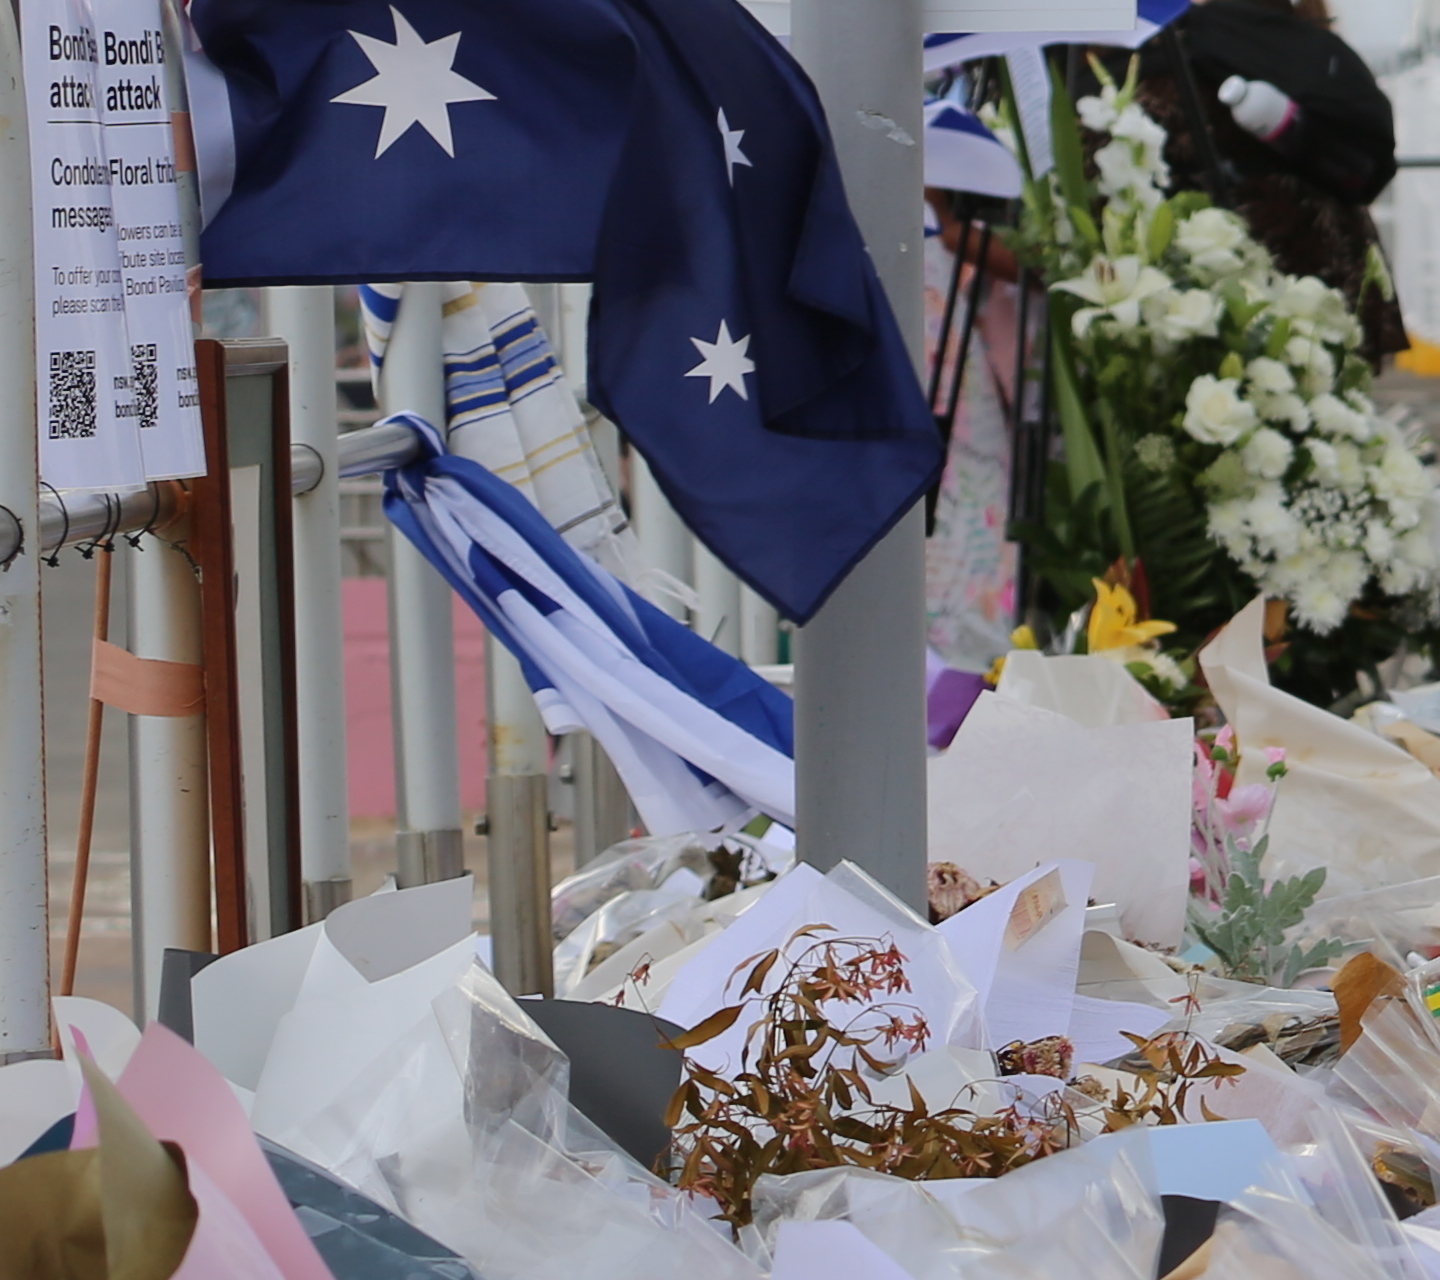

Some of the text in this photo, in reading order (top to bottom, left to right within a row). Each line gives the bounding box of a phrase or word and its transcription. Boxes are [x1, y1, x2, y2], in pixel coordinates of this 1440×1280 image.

[104, 30, 152, 65] Bondi
[107, 76, 162, 111] attack
[109, 157, 154, 186] Floral
[117, 223, 151, 241] lowers
[150, 248, 166, 267] site
[52, 267, 66, 285] To
[68, 266, 92, 285] offer
[126, 276, 157, 296] Bondi
[52, 296, 88, 317] please
